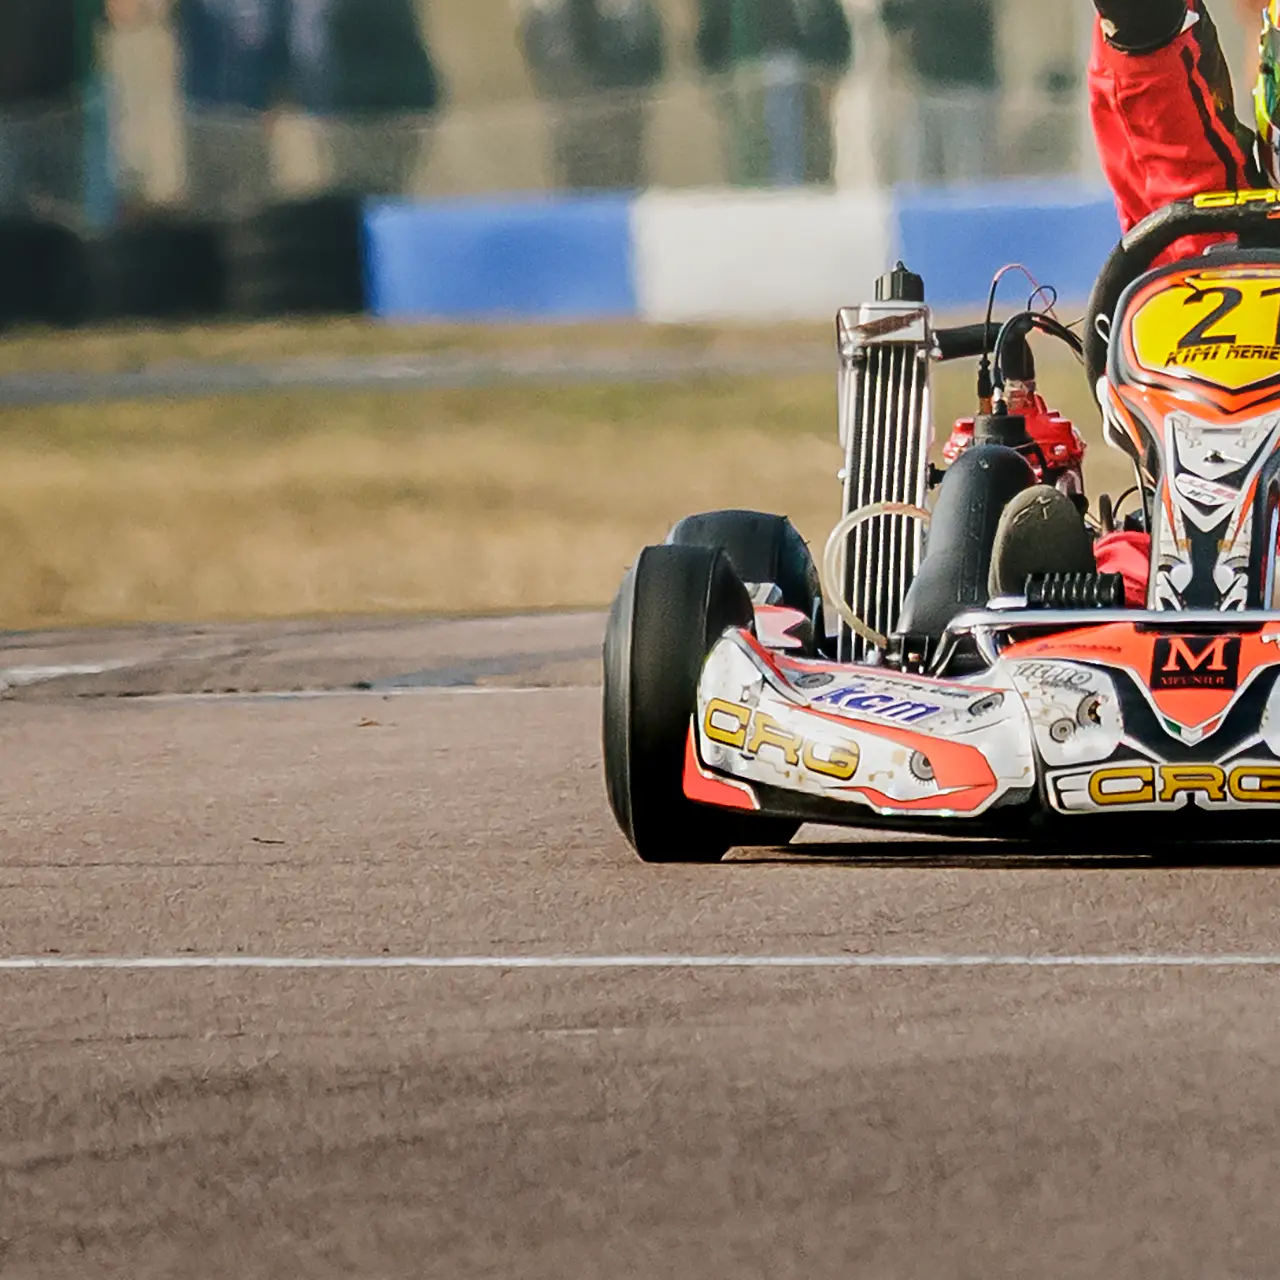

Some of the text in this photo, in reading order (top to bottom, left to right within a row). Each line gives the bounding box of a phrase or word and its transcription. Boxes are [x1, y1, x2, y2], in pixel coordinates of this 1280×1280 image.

[1162, 637, 1231, 671] M
[810, 682, 941, 723] kcm
[703, 696, 861, 782] CRG
